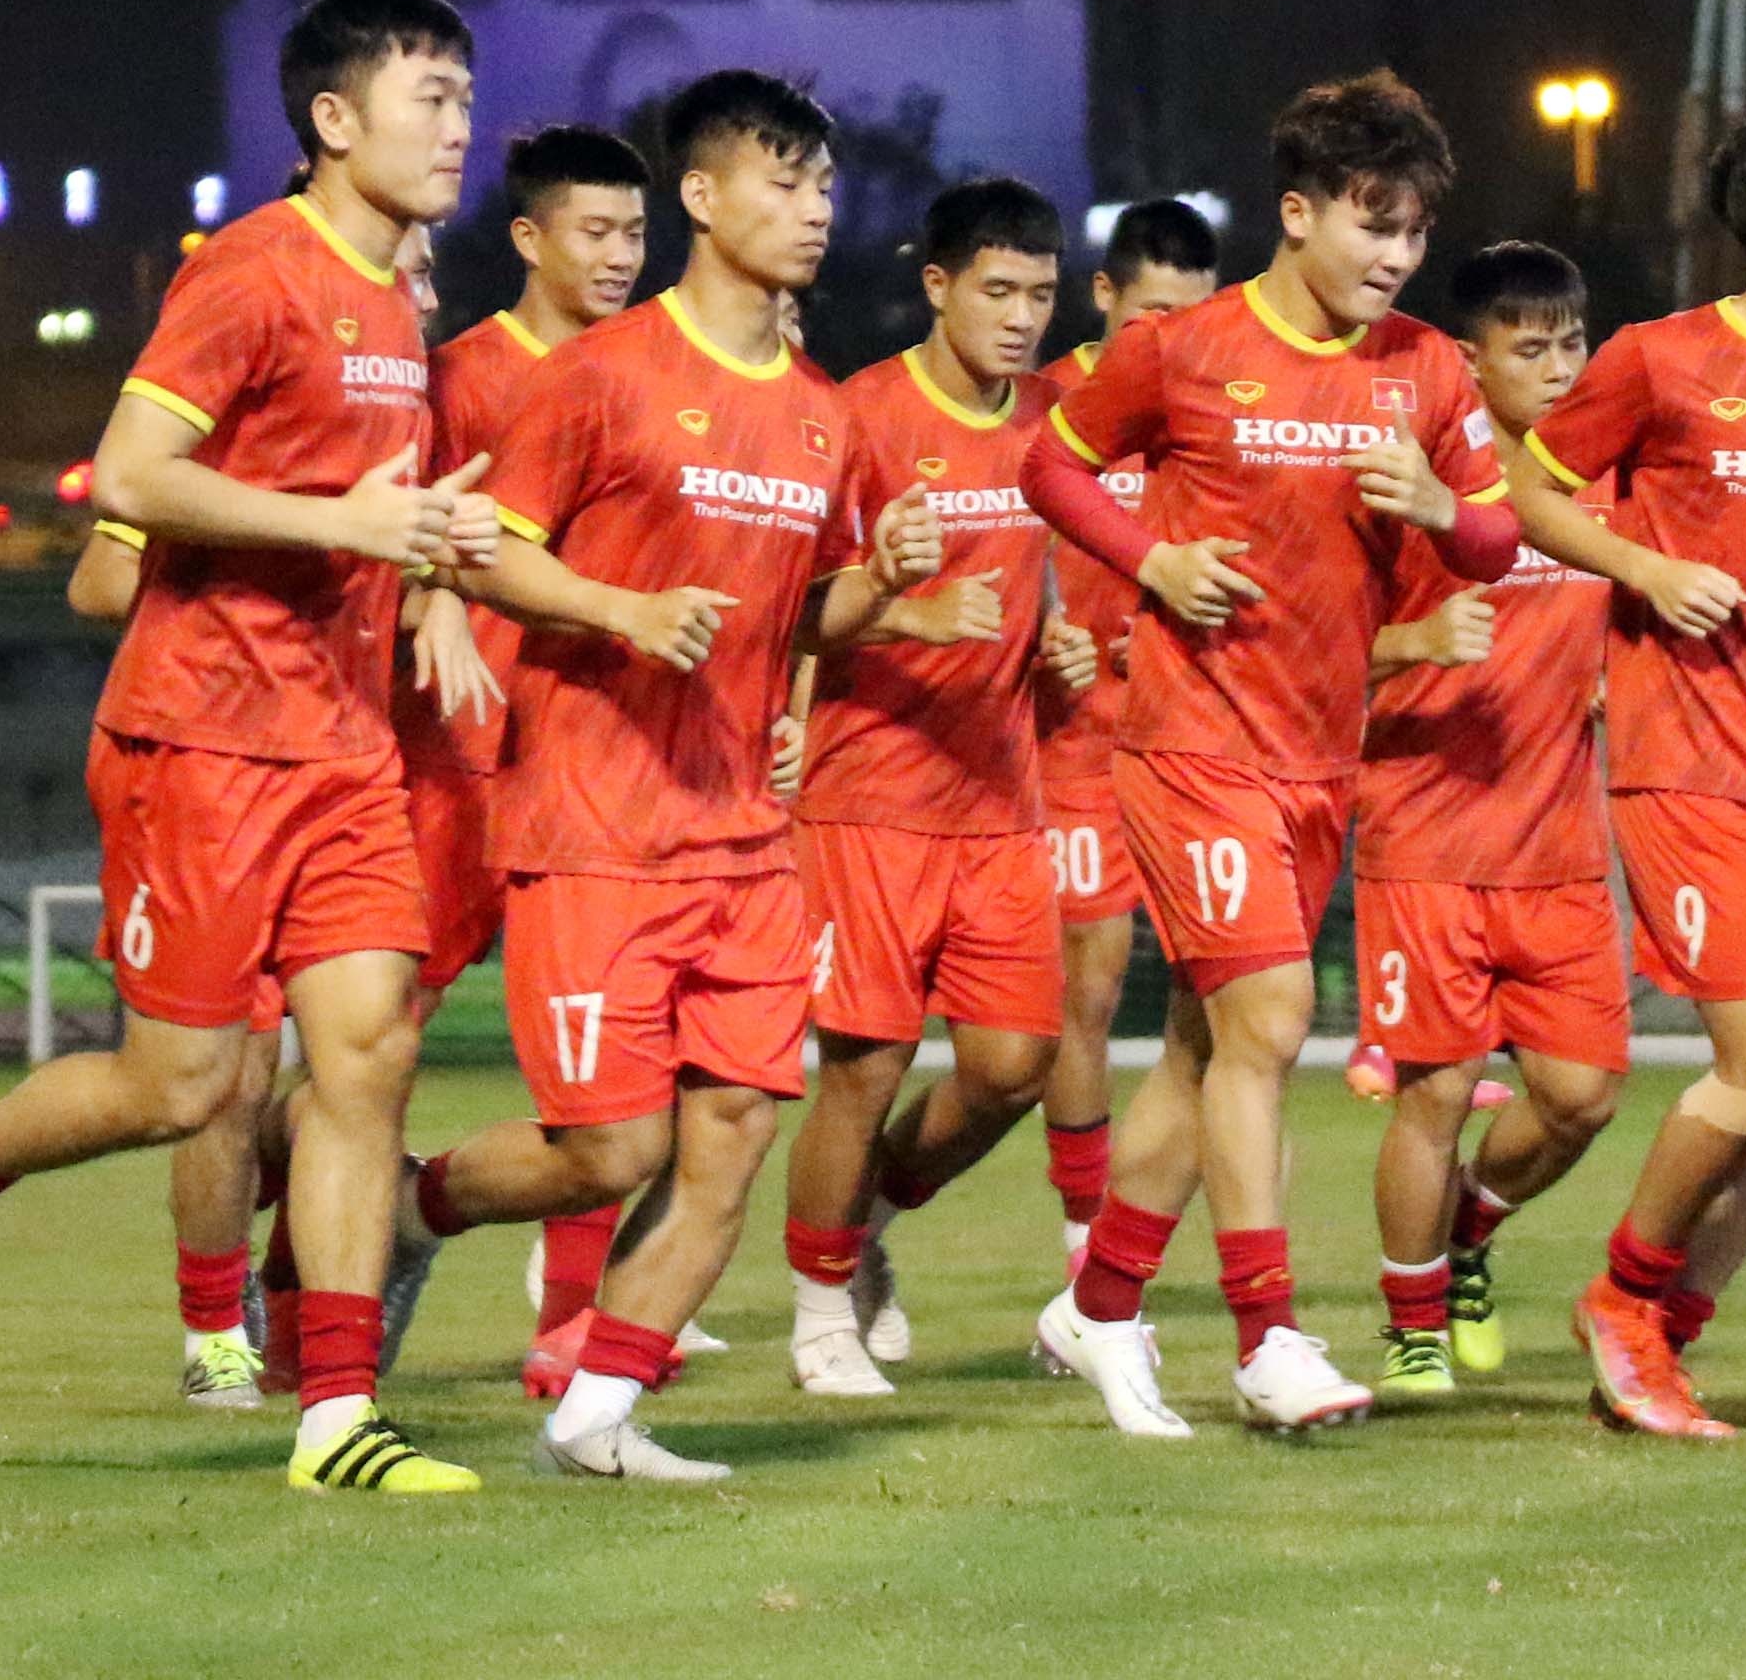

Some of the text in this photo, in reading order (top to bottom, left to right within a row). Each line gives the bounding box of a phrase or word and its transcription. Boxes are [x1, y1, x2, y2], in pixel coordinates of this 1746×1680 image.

[678, 465, 828, 518] HONDA
[1239, 449, 1271, 464] The
[1273, 451, 1325, 467] Power
[692, 501, 720, 518] The
[721, 505, 755, 523] Power
[756, 512, 775, 526] of
[938, 521, 954, 531] he
[956, 518, 997, 530] Power
[998, 516, 1014, 528] of
[1546, 570, 1562, 582] of
[1046, 827, 1101, 895] 30
[1184, 837, 1247, 923] 19
[122, 883, 154, 970] 6
[1674, 885, 1708, 967] 9
[1375, 950, 1407, 1026] 3
[548, 992, 604, 1083] 17
